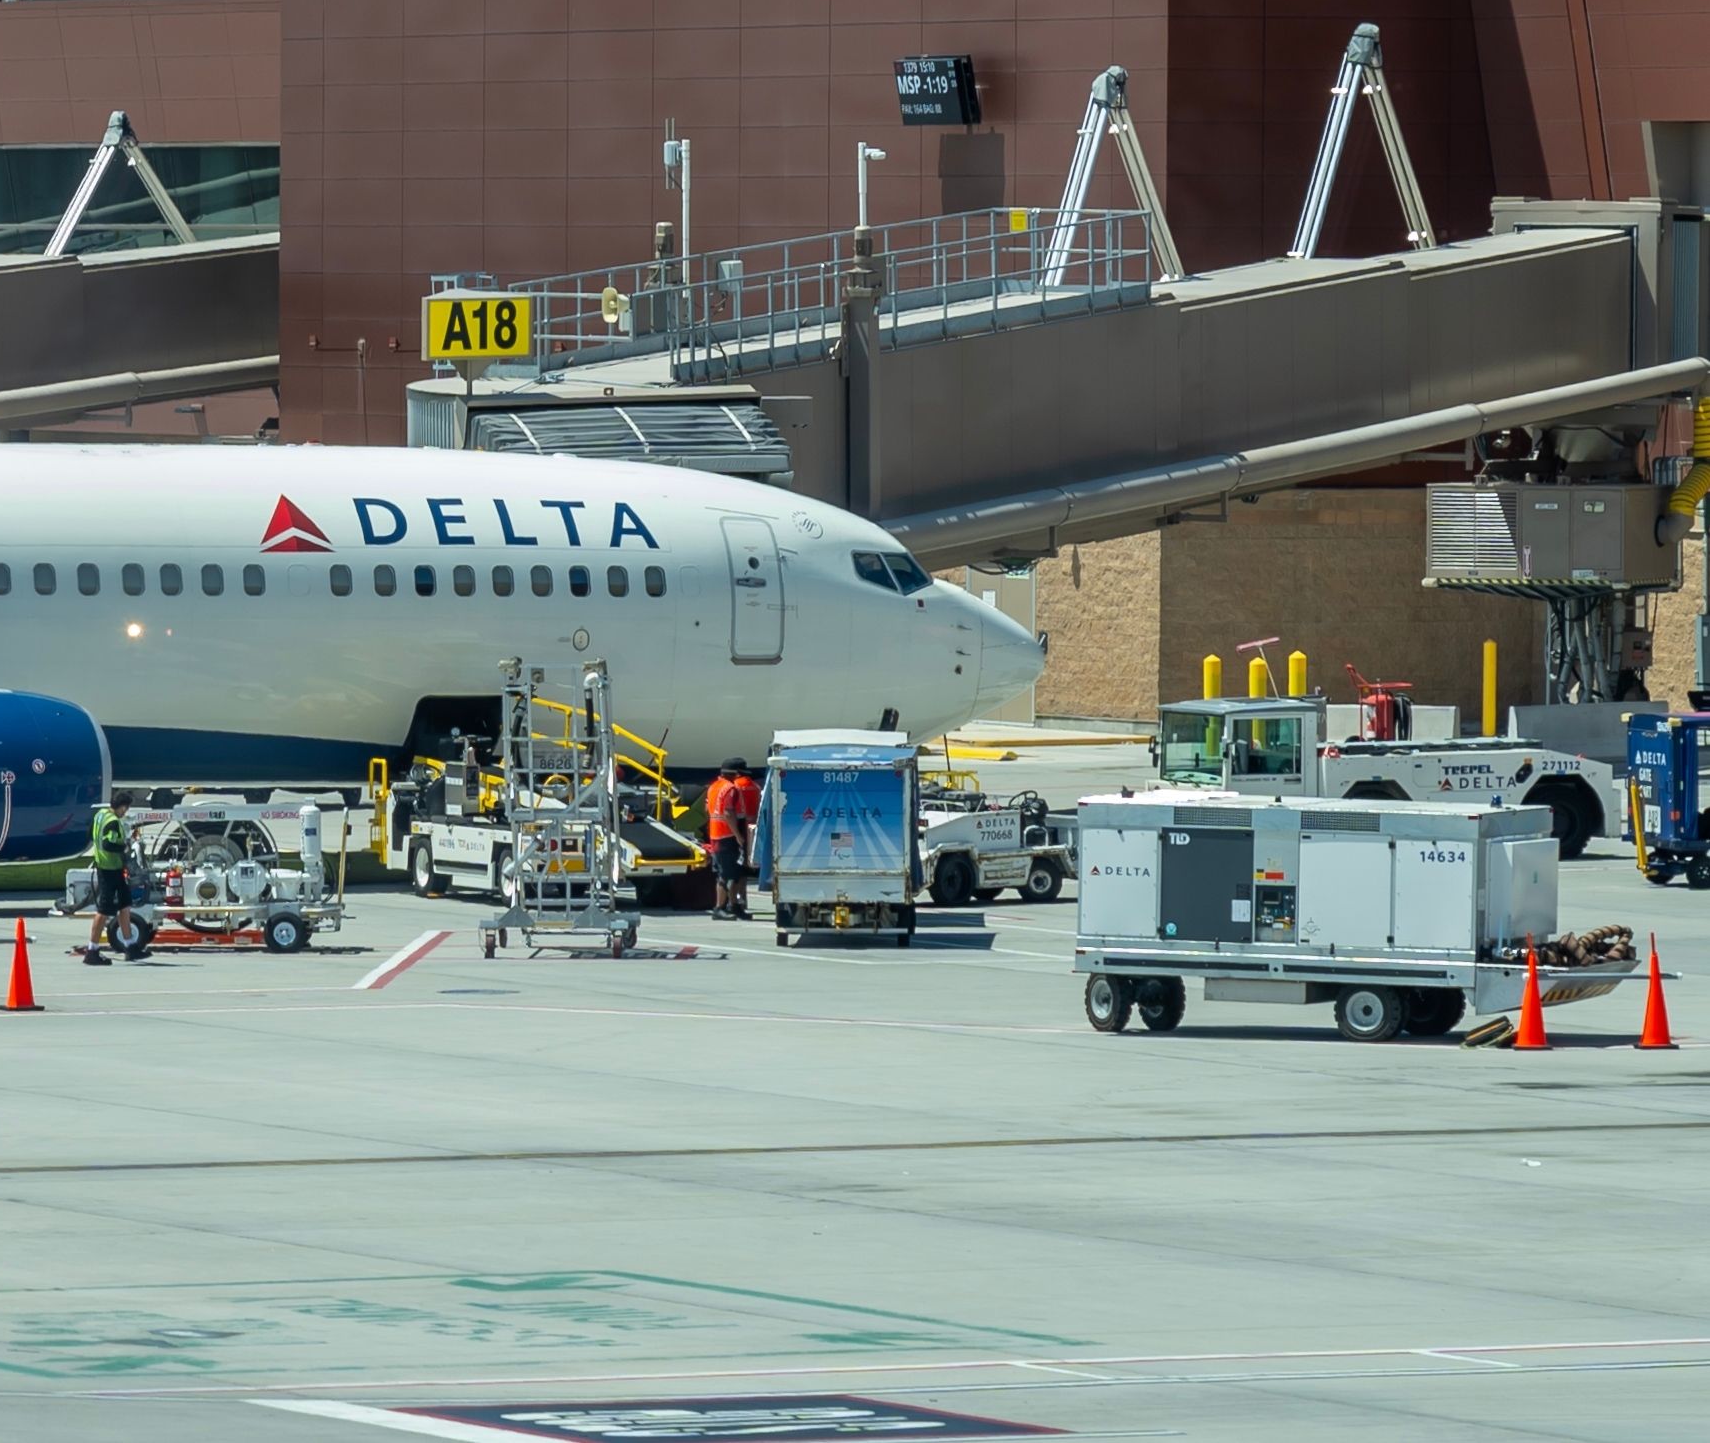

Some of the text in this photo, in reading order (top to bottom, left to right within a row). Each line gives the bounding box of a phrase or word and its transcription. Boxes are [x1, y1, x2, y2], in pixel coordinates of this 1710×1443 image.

[897, 75, 948, 94] MSP -1:19
[442, 300, 517, 350] A18
[352, 497, 661, 549] DELTA
[1642, 751, 1666, 766] DELTA
[1442, 764, 1494, 776] TREPEL
[1542, 761, 1581, 771] 271112
[823, 772, 859, 783] 81487
[1459, 776, 1517, 789] DELTA
[822, 807, 882, 819] DELTA
[985, 818, 1016, 828] DELTA
[981, 830, 1013, 841] 770668
[1169, 833, 1190, 845] TLD
[1420, 850, 1466, 863] 14634
[1105, 866, 1151, 877] DELTA
